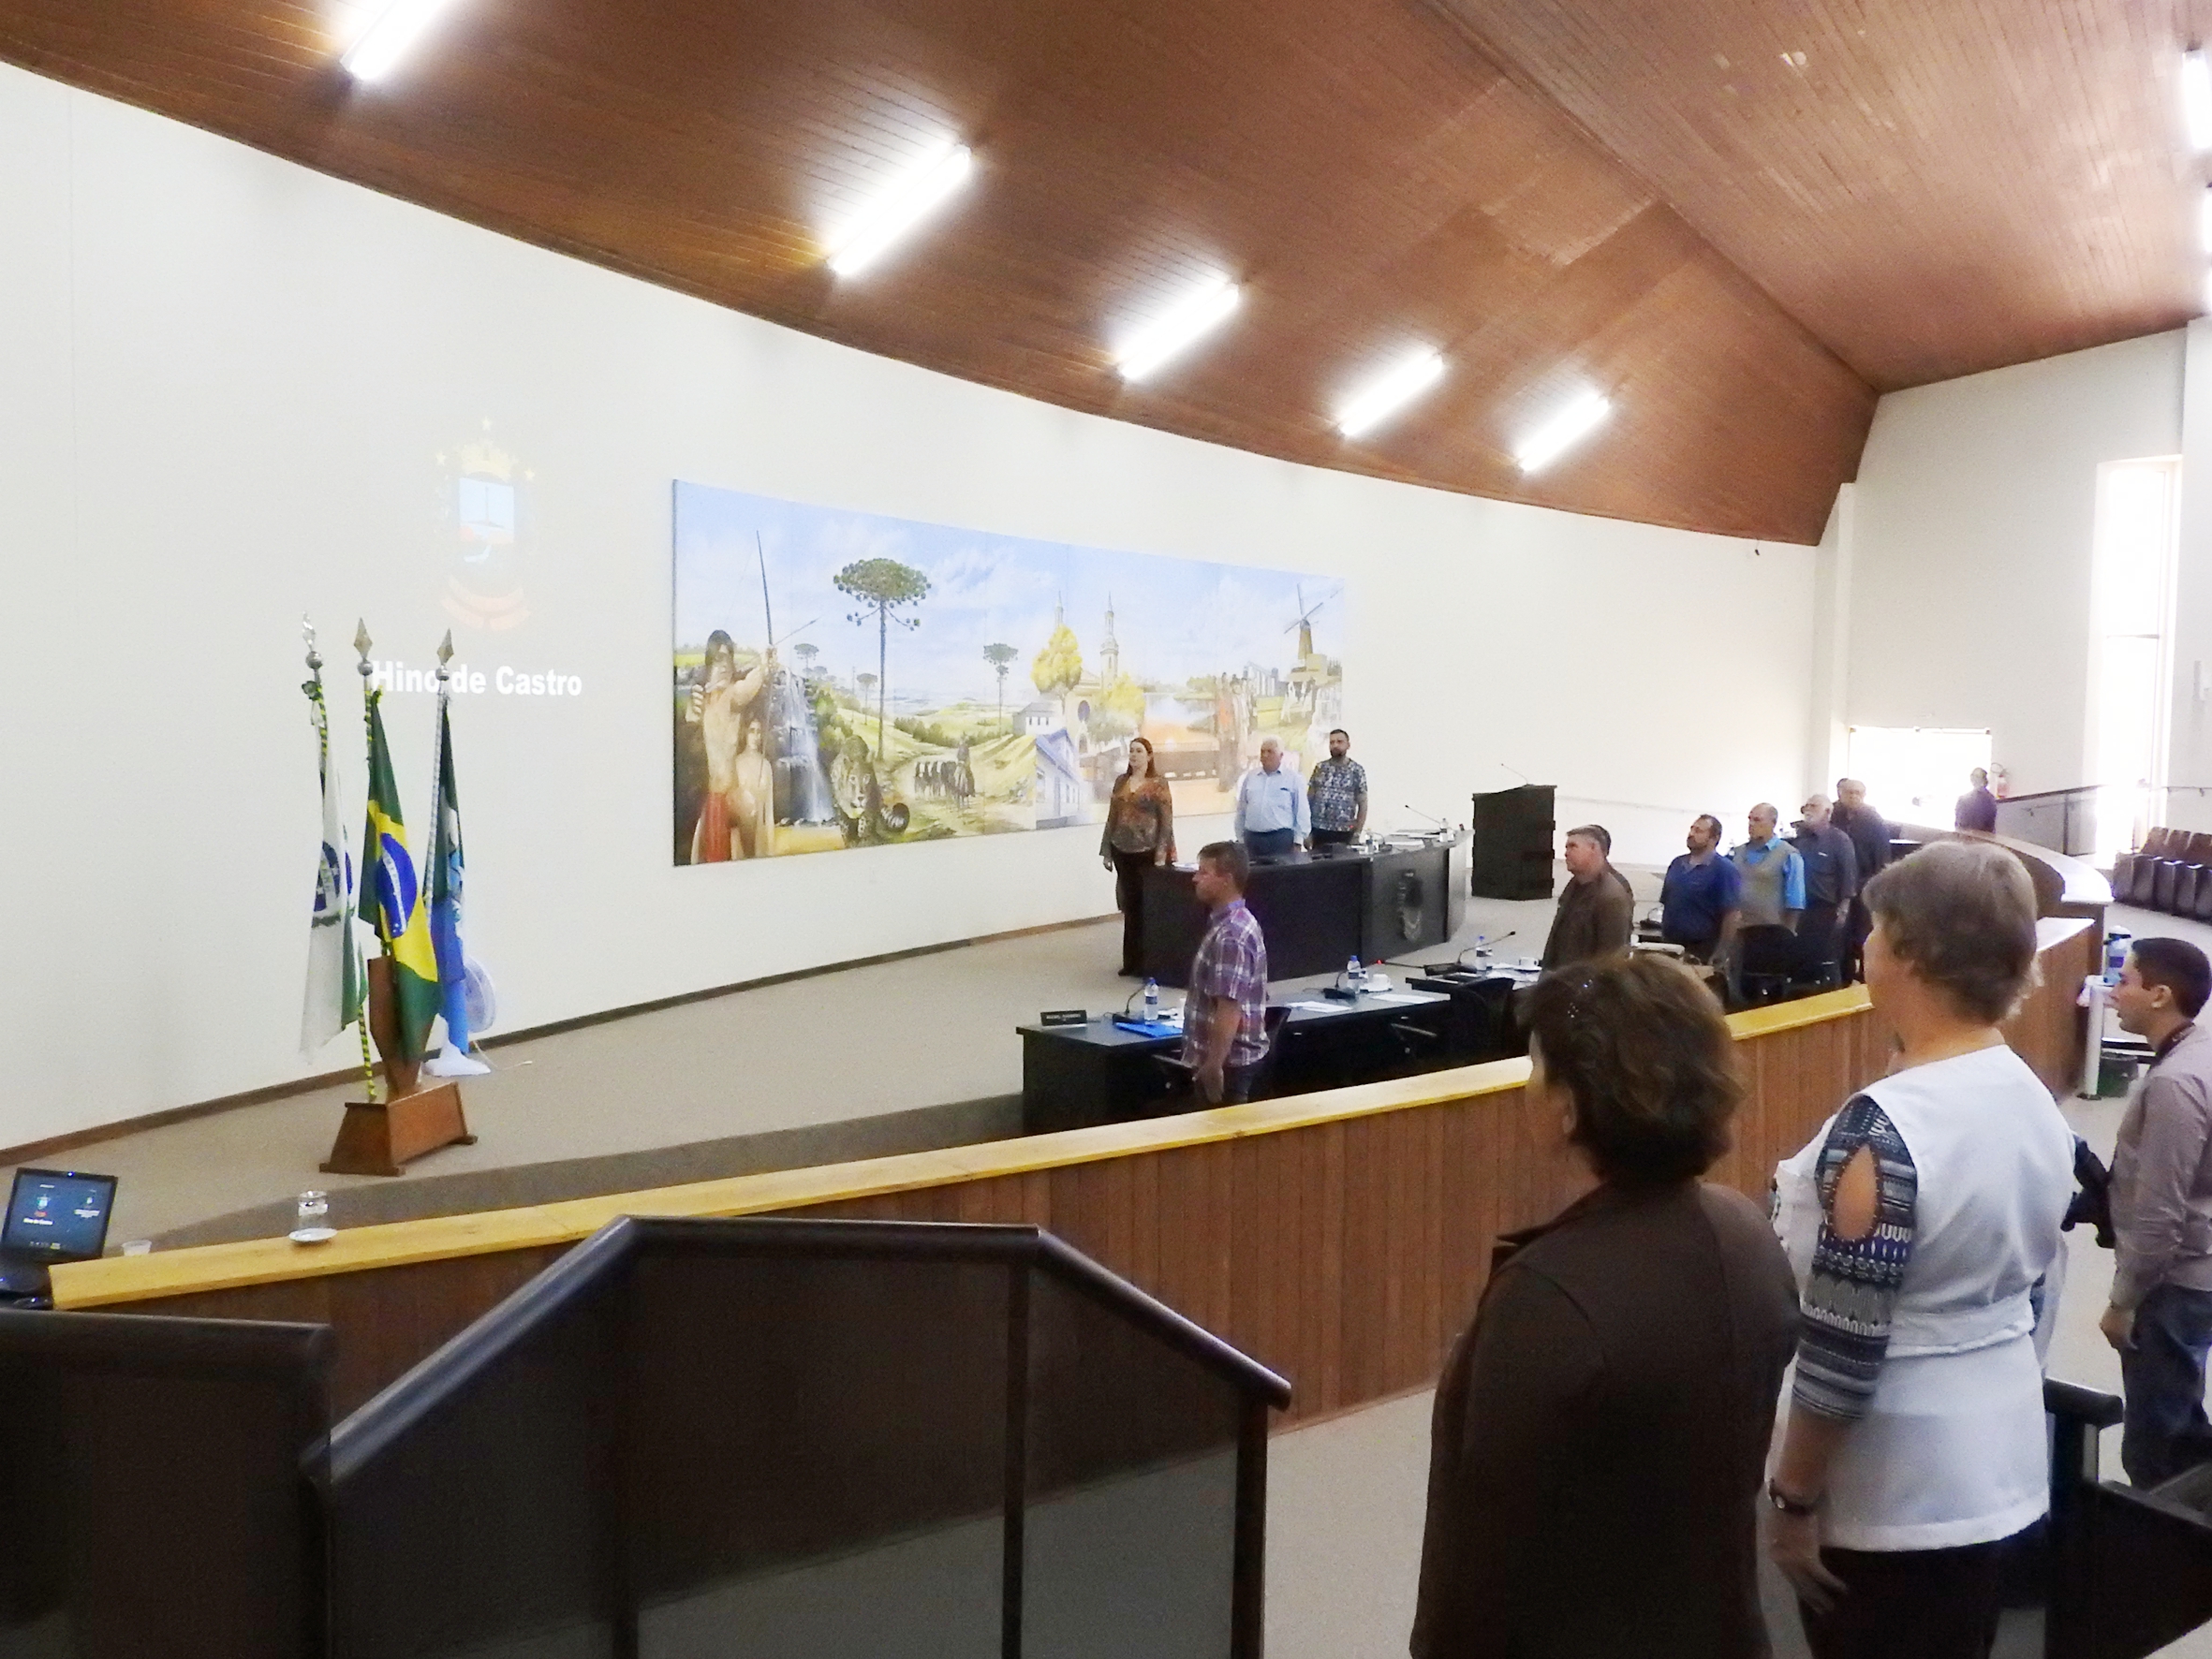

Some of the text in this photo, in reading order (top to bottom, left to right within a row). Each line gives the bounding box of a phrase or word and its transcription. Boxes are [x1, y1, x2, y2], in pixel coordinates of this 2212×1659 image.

[372, 660, 582, 696] Hino de Castro
